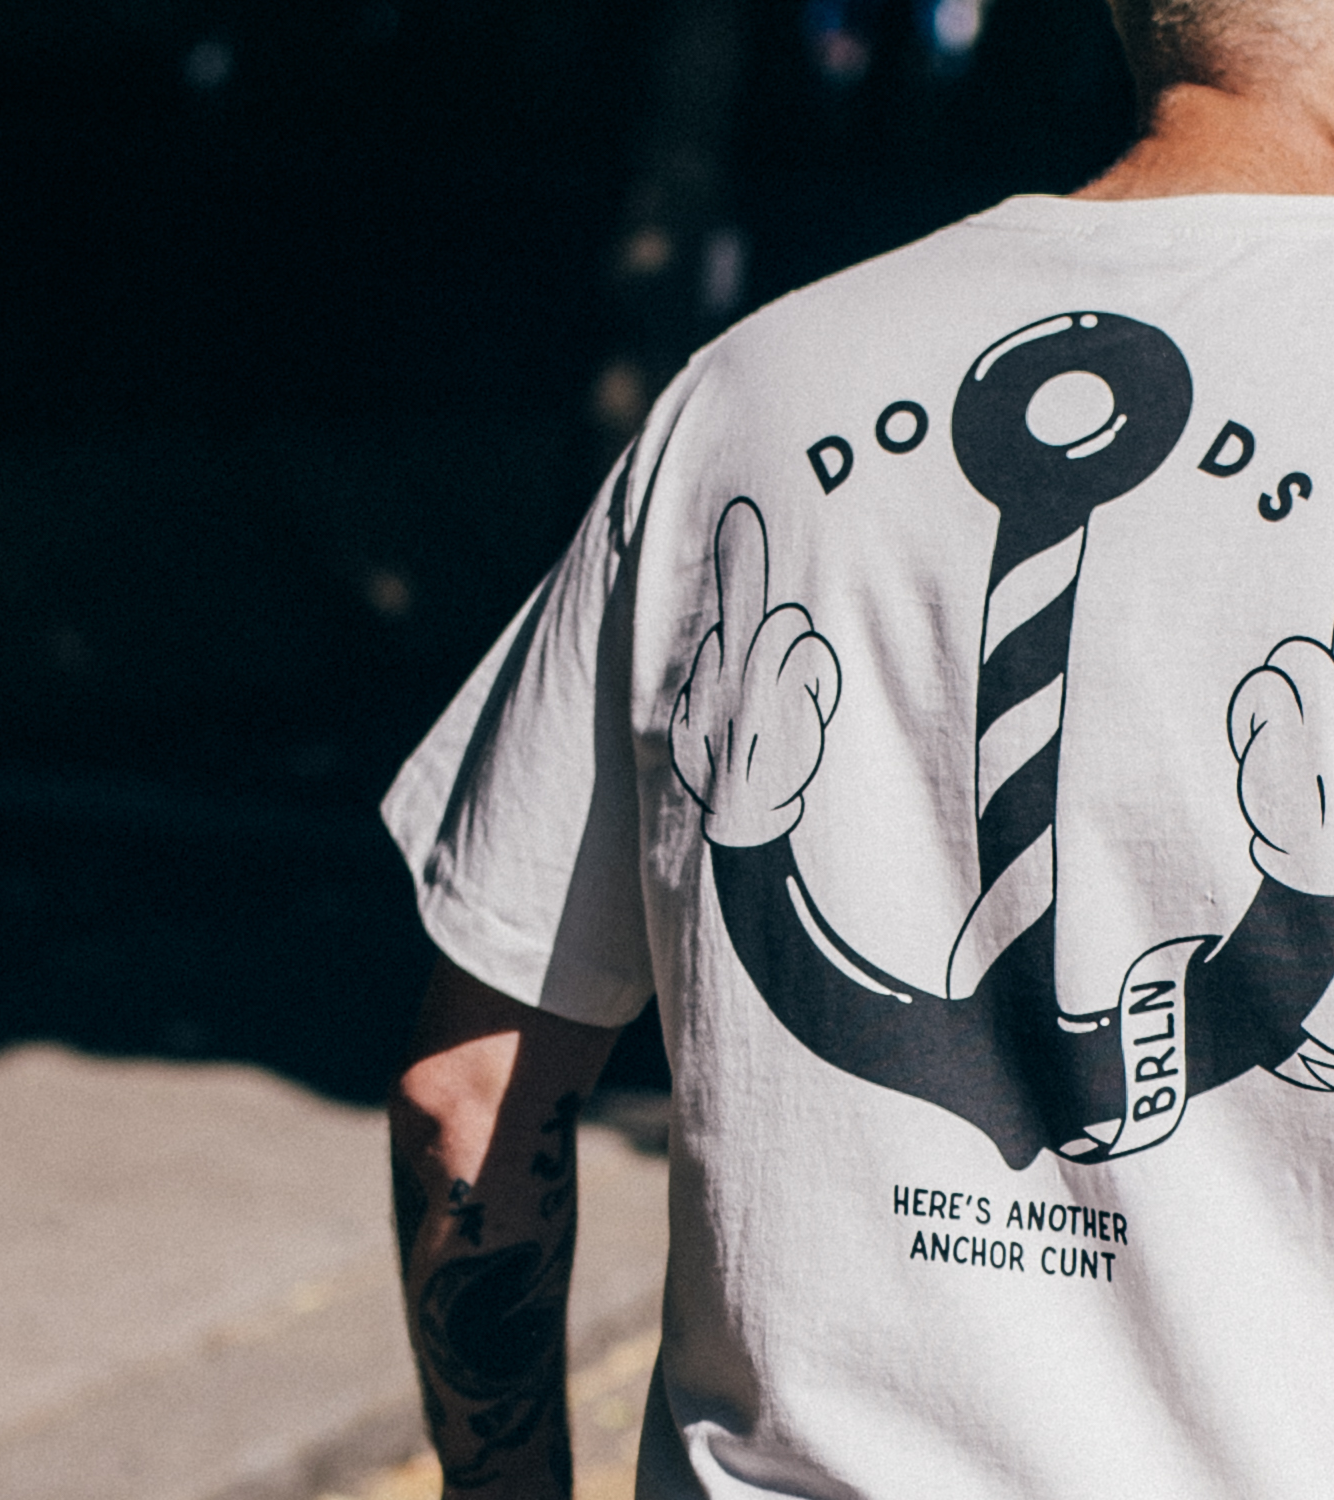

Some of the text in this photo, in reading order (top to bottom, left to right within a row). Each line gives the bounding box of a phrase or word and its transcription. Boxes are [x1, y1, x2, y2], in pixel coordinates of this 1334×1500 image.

[1128, 979, 1179, 1122] BRLN
[893, 1184, 1129, 1246] HERE'S ANOTHER
[909, 1230, 1117, 1283] ANCHOR CUNT
